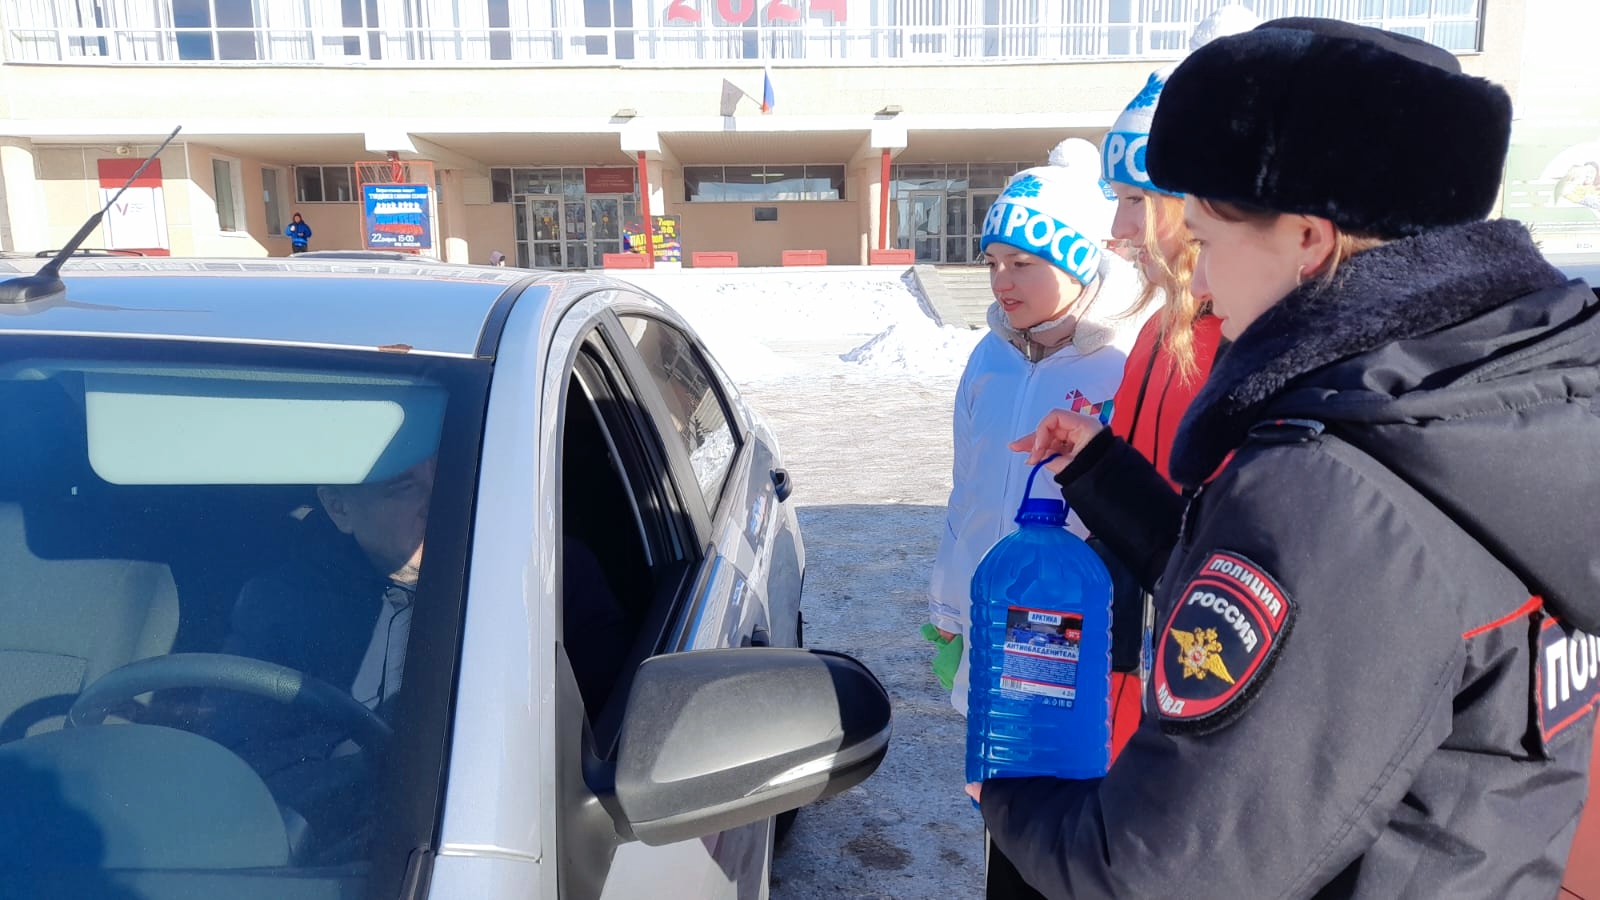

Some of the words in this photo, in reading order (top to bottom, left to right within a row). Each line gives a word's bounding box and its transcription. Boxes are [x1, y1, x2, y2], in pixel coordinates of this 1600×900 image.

[1209, 558, 1282, 618] ПОЛИЦИЯ
[1031, 613, 1058, 624] АРКТИКА
[1187, 591, 1258, 653] РОССИЯ
[1006, 642, 1077, 659] АНТИОБЛЕДЕНИТЕЛЬ
[1157, 682, 1186, 714] МВД
